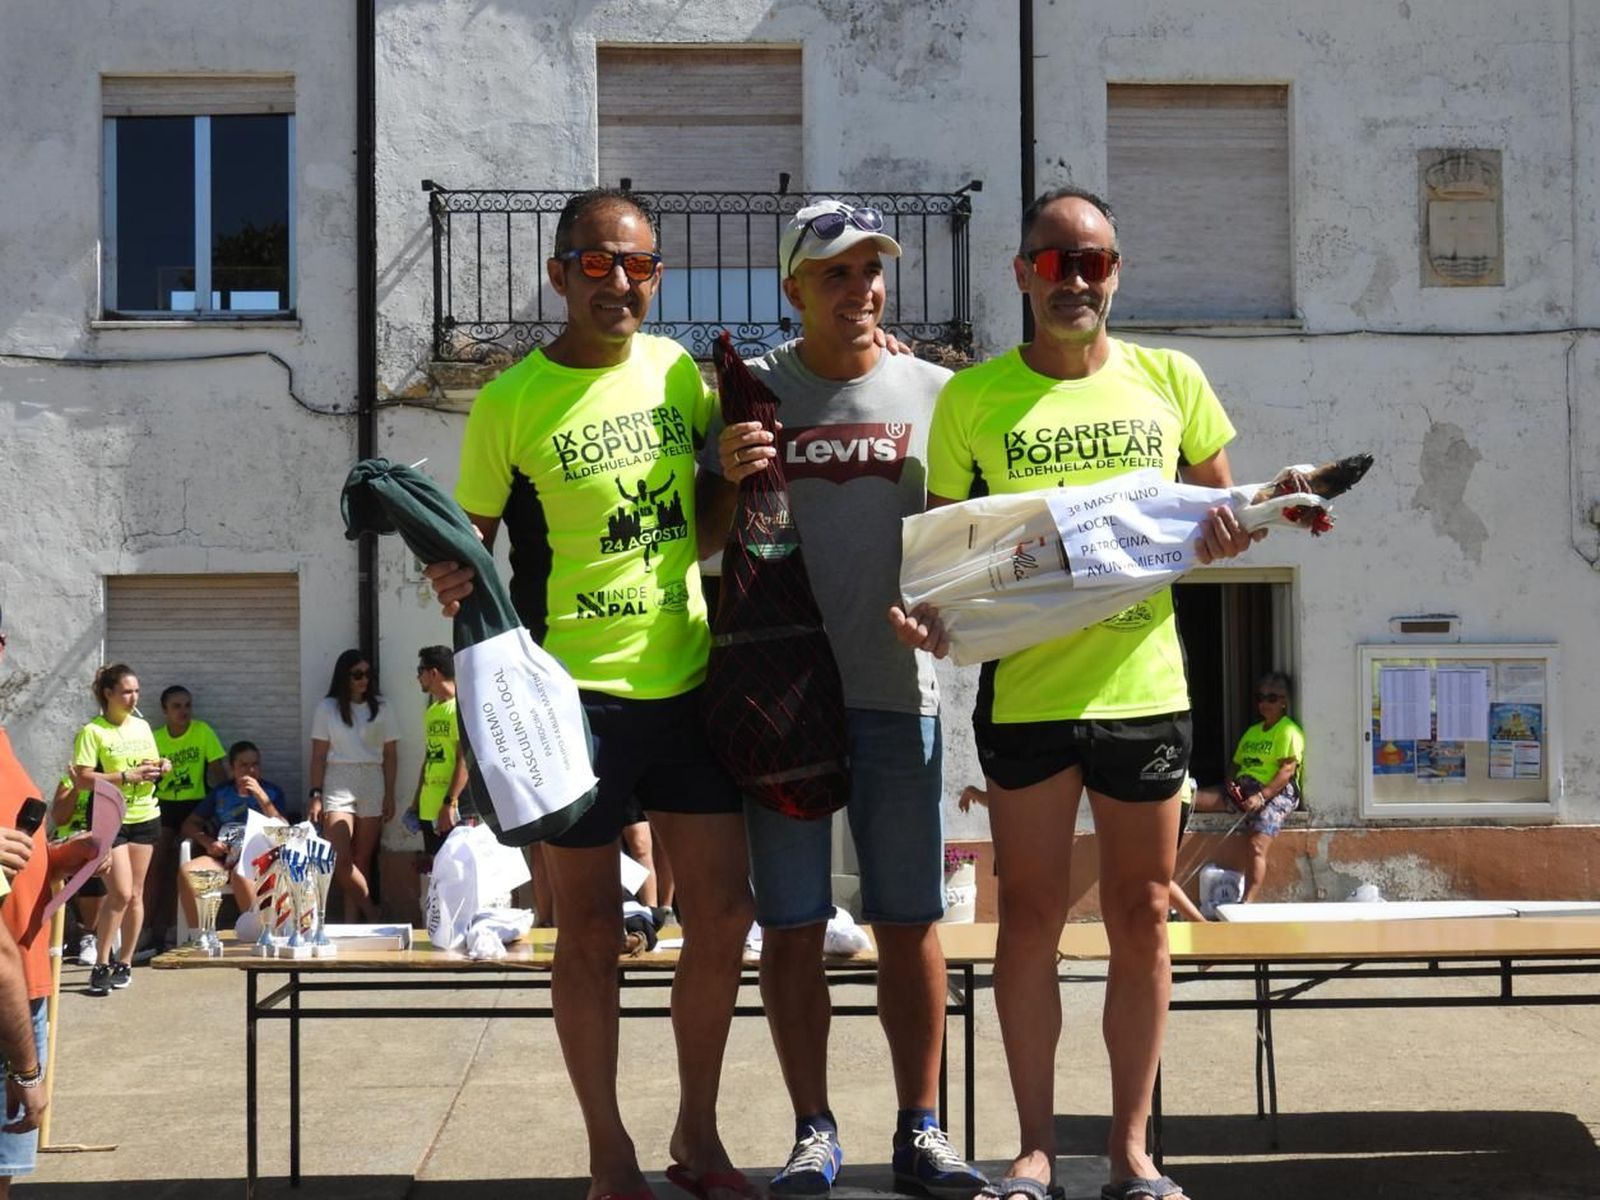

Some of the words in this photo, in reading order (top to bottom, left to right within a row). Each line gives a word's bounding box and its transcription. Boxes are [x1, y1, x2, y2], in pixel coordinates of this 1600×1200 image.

[552, 430, 577, 452] IX
[582, 405, 684, 441] CARRERA
[1004, 430, 1028, 449] IX
[1036, 419, 1163, 443] CARRERA
[559, 423, 691, 472] POPULAR
[1006, 435, 1163, 470] POPULAR
[563, 455, 642, 483] ALDEHUELA
[643, 450, 661, 463] DE
[1008, 460, 1092, 480] ALDEHUELA
[1096, 458, 1116, 470] DE
[1120, 456, 1164, 469] YELTES
[1084, 486, 1159, 511] MASCULINO
[604, 540, 625, 553] 24
[628, 524, 686, 549] AGOSTO
[1077, 515, 1118, 534] LOCAL
[1080, 534, 1150, 557] PATROCINA
[607, 586, 648, 601] INDE
[608, 601, 648, 617] PAL
[494, 668, 515, 709] LOCAL
[482, 702, 508, 753] PREMIO
[530, 708, 552, 757] PATROCINA
[509, 711, 544, 788] MASCULINO
